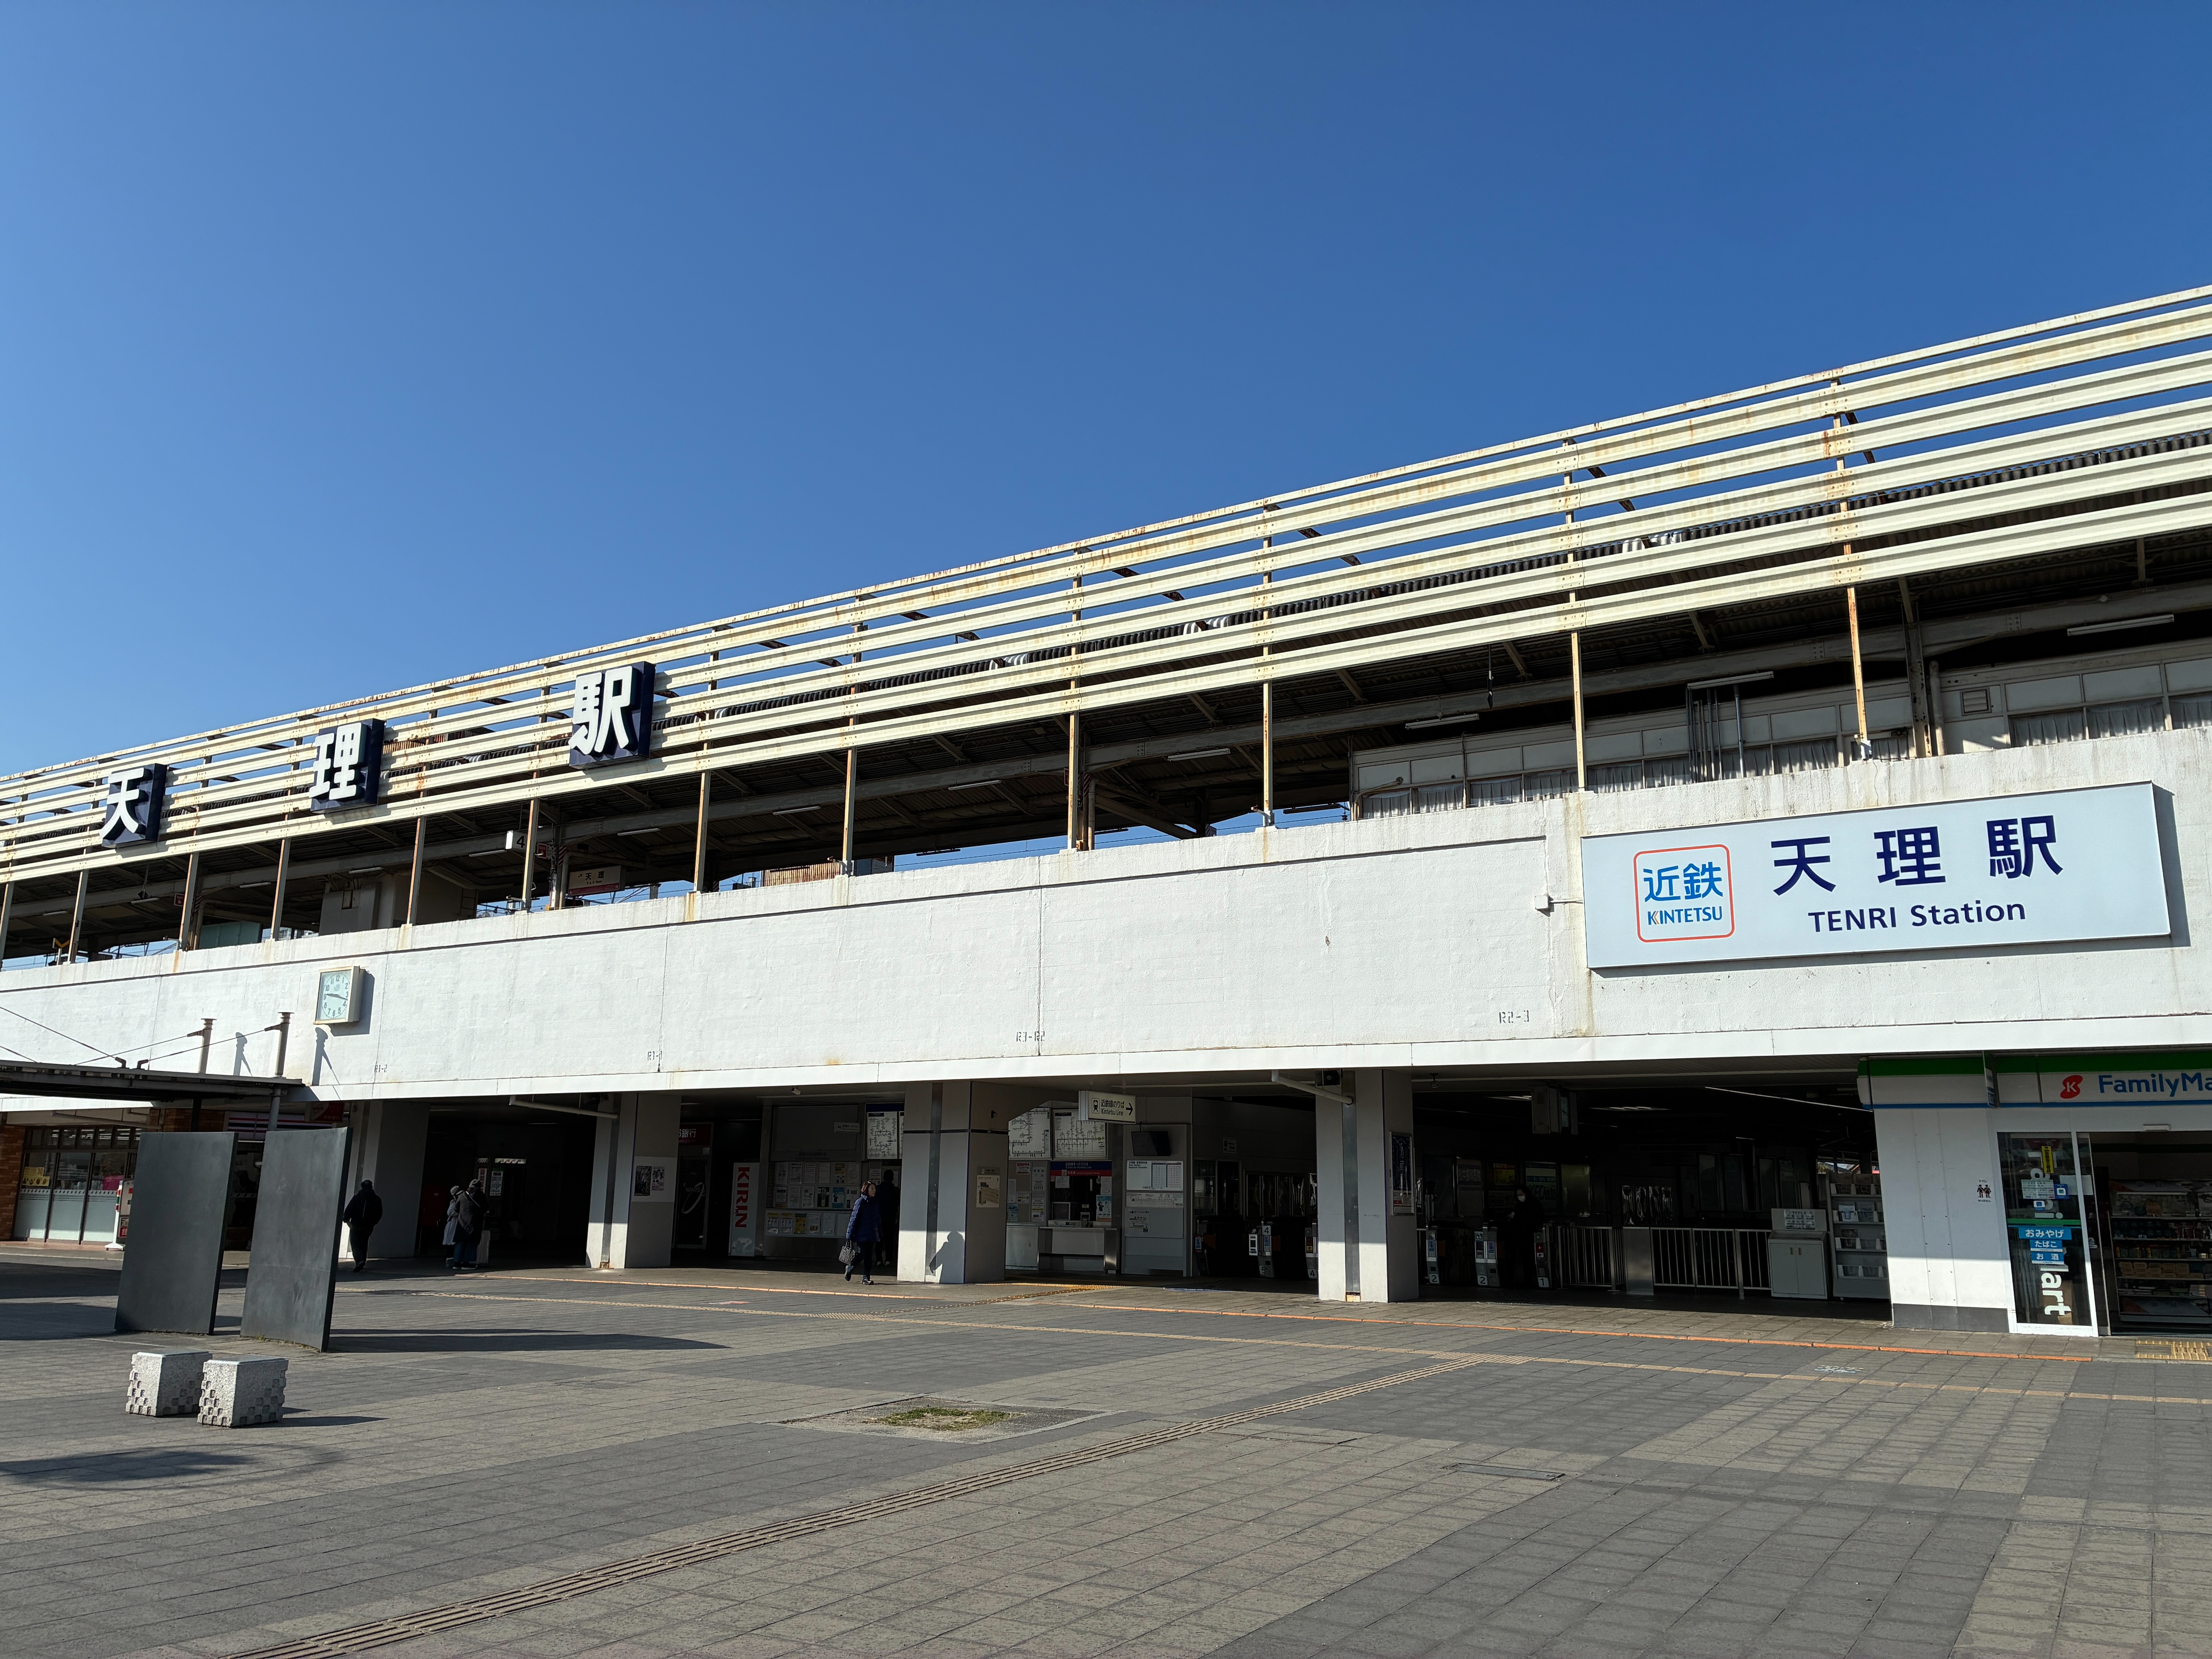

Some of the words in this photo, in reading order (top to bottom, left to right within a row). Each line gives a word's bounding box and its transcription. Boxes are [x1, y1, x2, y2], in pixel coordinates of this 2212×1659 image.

[99, 665, 633, 837] 天理駅
[517, 836, 525, 848] 4
[1771, 815, 2063, 896] 天理駅
[1643, 862, 1723, 902] 近鉄
[1648, 906, 1722, 925] KINTETSU
[1808, 907, 1896, 932] TENRI
[1910, 900, 2026, 927] Station
[1101, 1099, 1125, 1108] 近鉄線のりば
[735, 1167, 750, 1228] KIRIN
[2025, 1229, 2064, 1238] おみやげ
